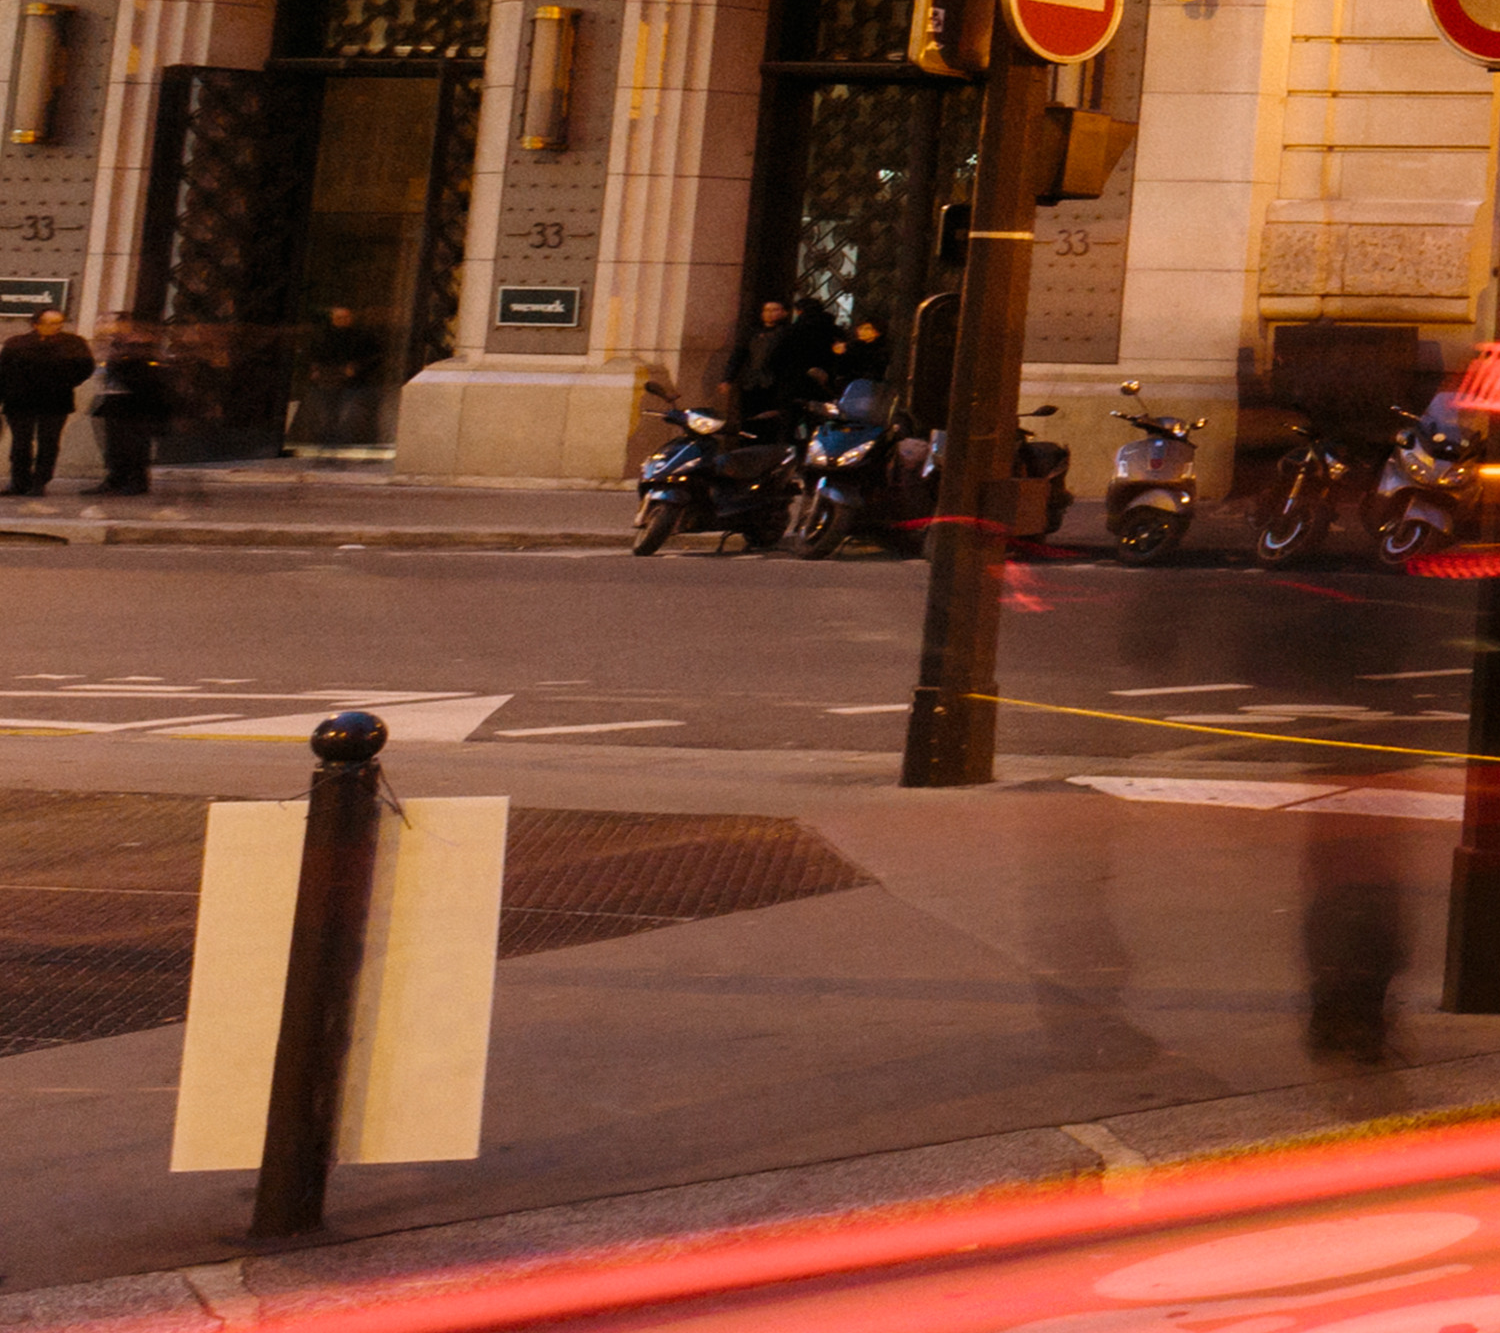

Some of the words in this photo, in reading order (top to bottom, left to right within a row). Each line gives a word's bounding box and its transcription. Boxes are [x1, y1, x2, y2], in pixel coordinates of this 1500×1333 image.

[22, 215, 54, 242] 33
[529, 222, 564, 249] 33
[1056, 229, 1090, 256] 33
